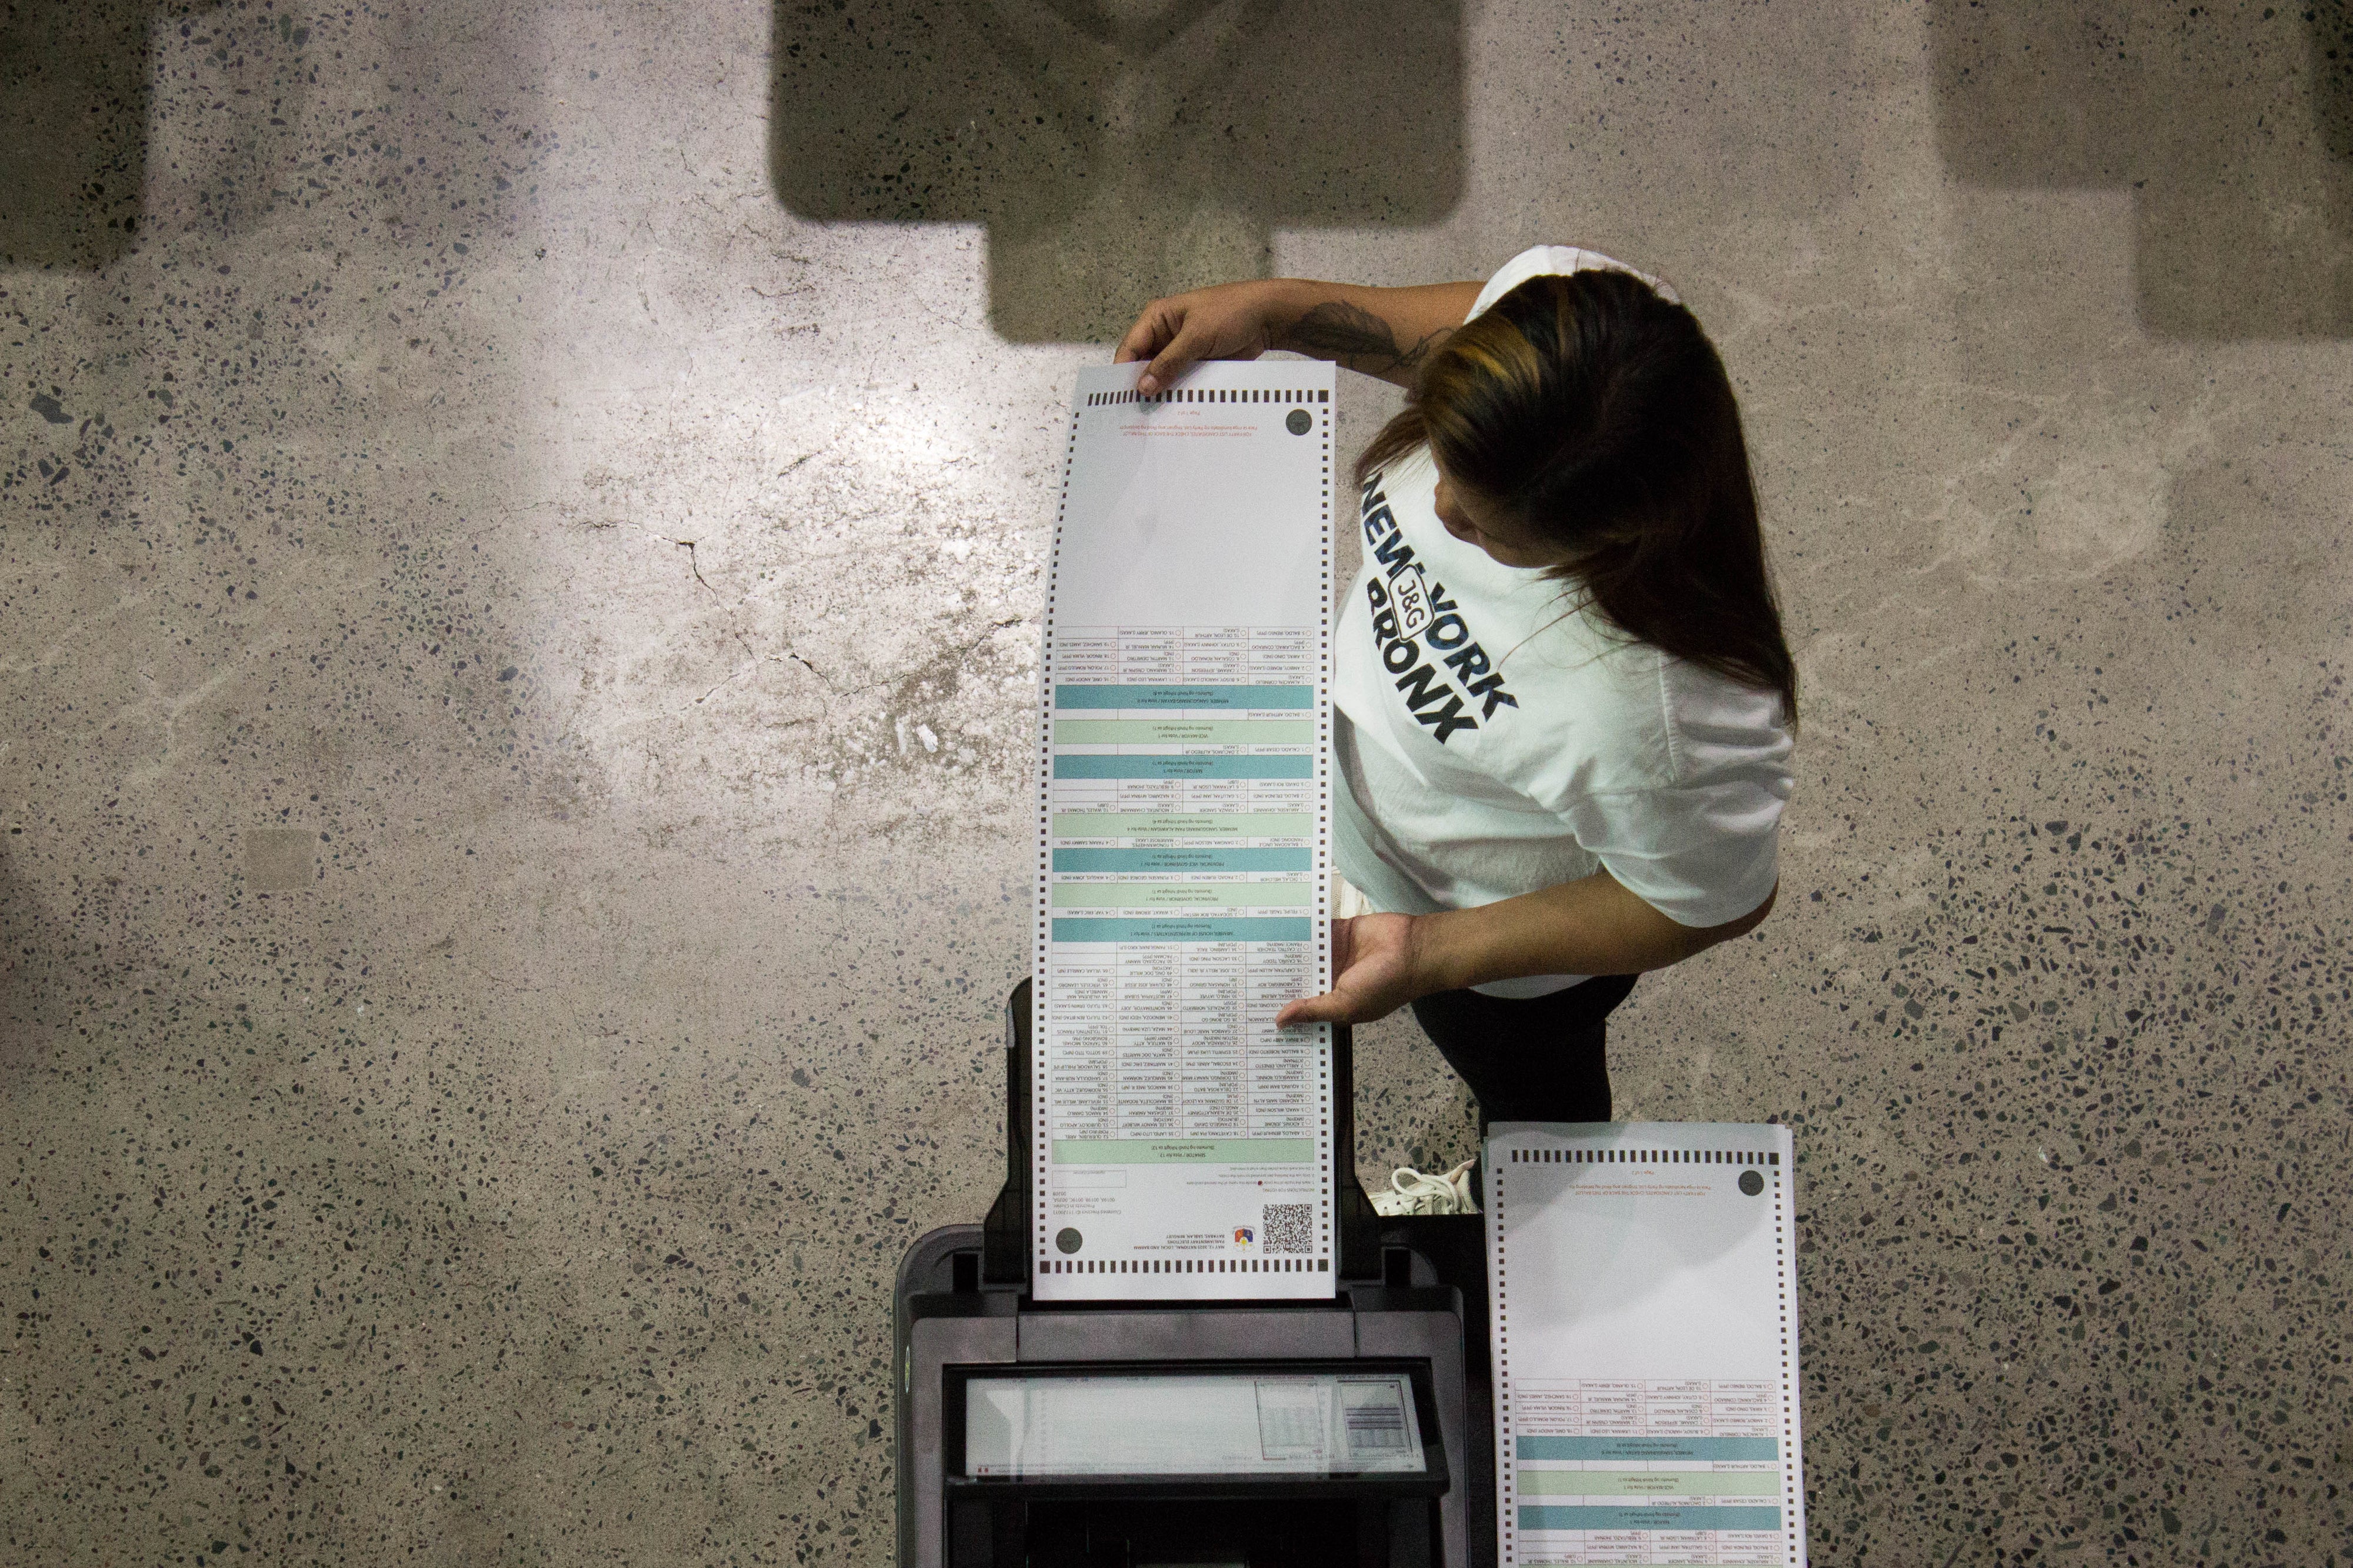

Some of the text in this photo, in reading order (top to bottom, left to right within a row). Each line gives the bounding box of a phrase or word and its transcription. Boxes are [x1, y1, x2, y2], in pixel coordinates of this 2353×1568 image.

[1361, 473, 1519, 722] NEW YORK
[1367, 576, 1479, 745] BRONX
[1398, 579, 1425, 629] J&G
